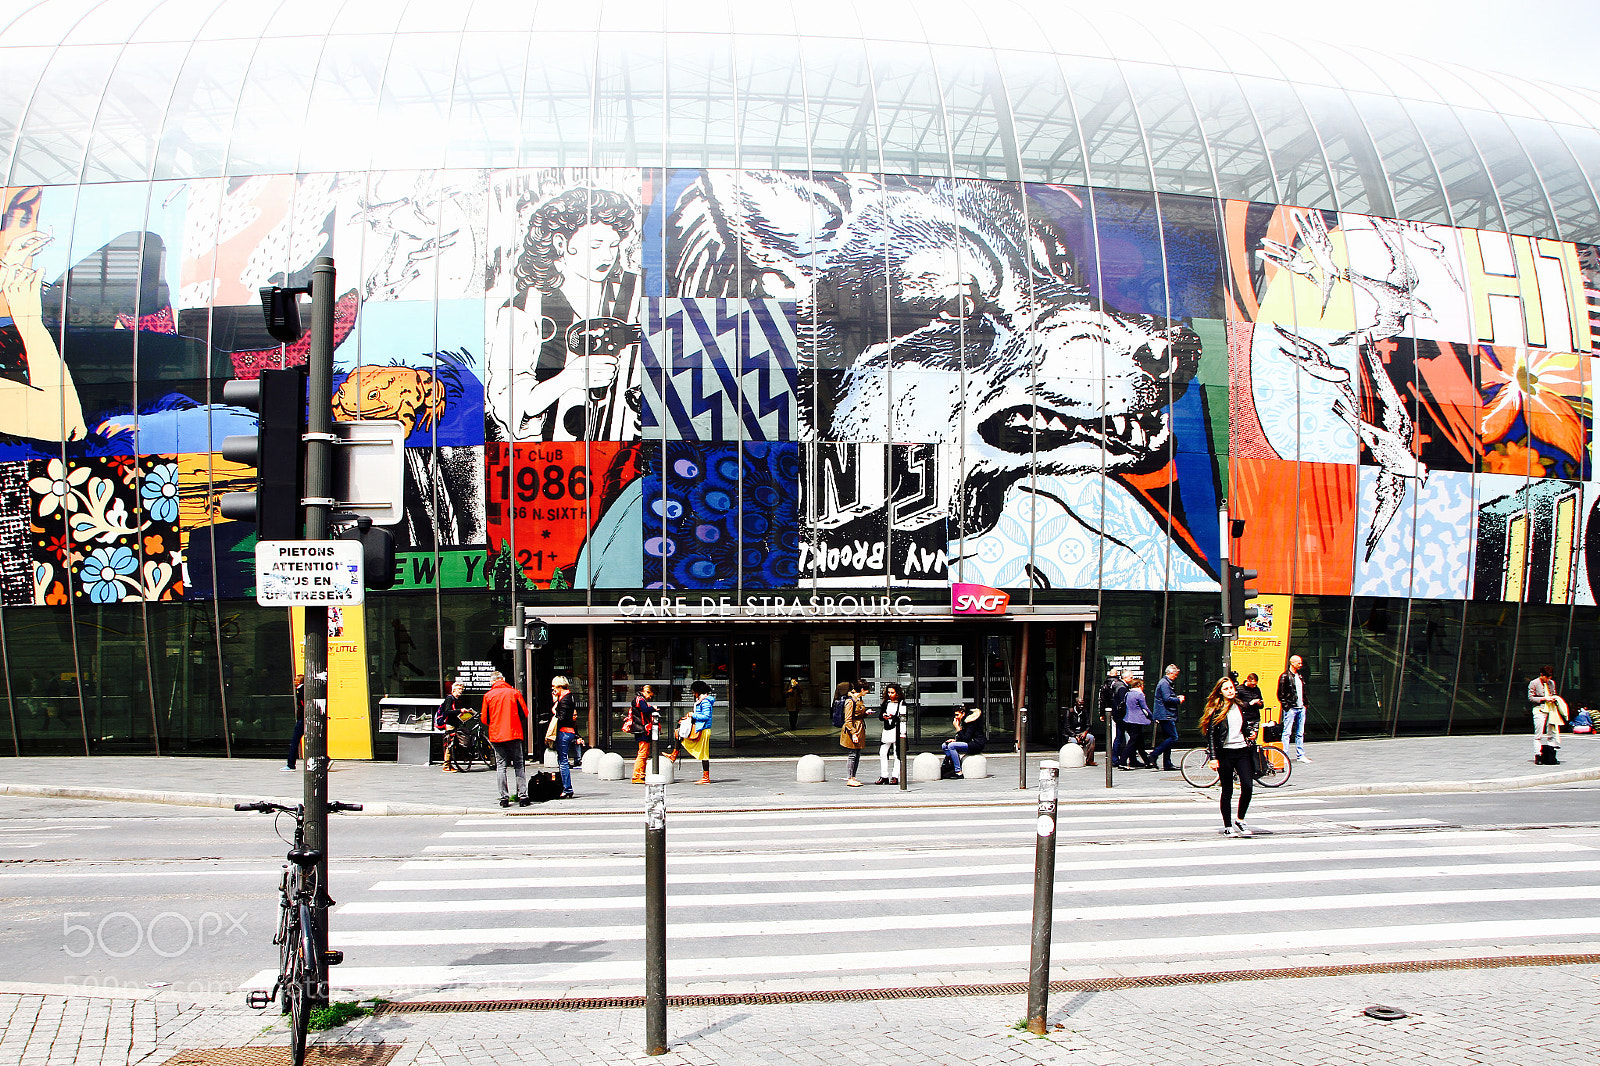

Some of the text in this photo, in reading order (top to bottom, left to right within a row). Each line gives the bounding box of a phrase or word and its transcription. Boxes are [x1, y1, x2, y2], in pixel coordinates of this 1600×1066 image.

[528, 449, 563, 463] CLUB
[496, 465, 594, 502] 1986
[279, 547, 335, 557] PIETONS
[272, 561, 342, 571] ATTENTIO
[314, 576, 331, 586] EN
[617, 595, 914, 617] GARE DE STRASBOURG
[954, 594, 1007, 612] SNCF
[335, 645, 358, 653] LITTLE
